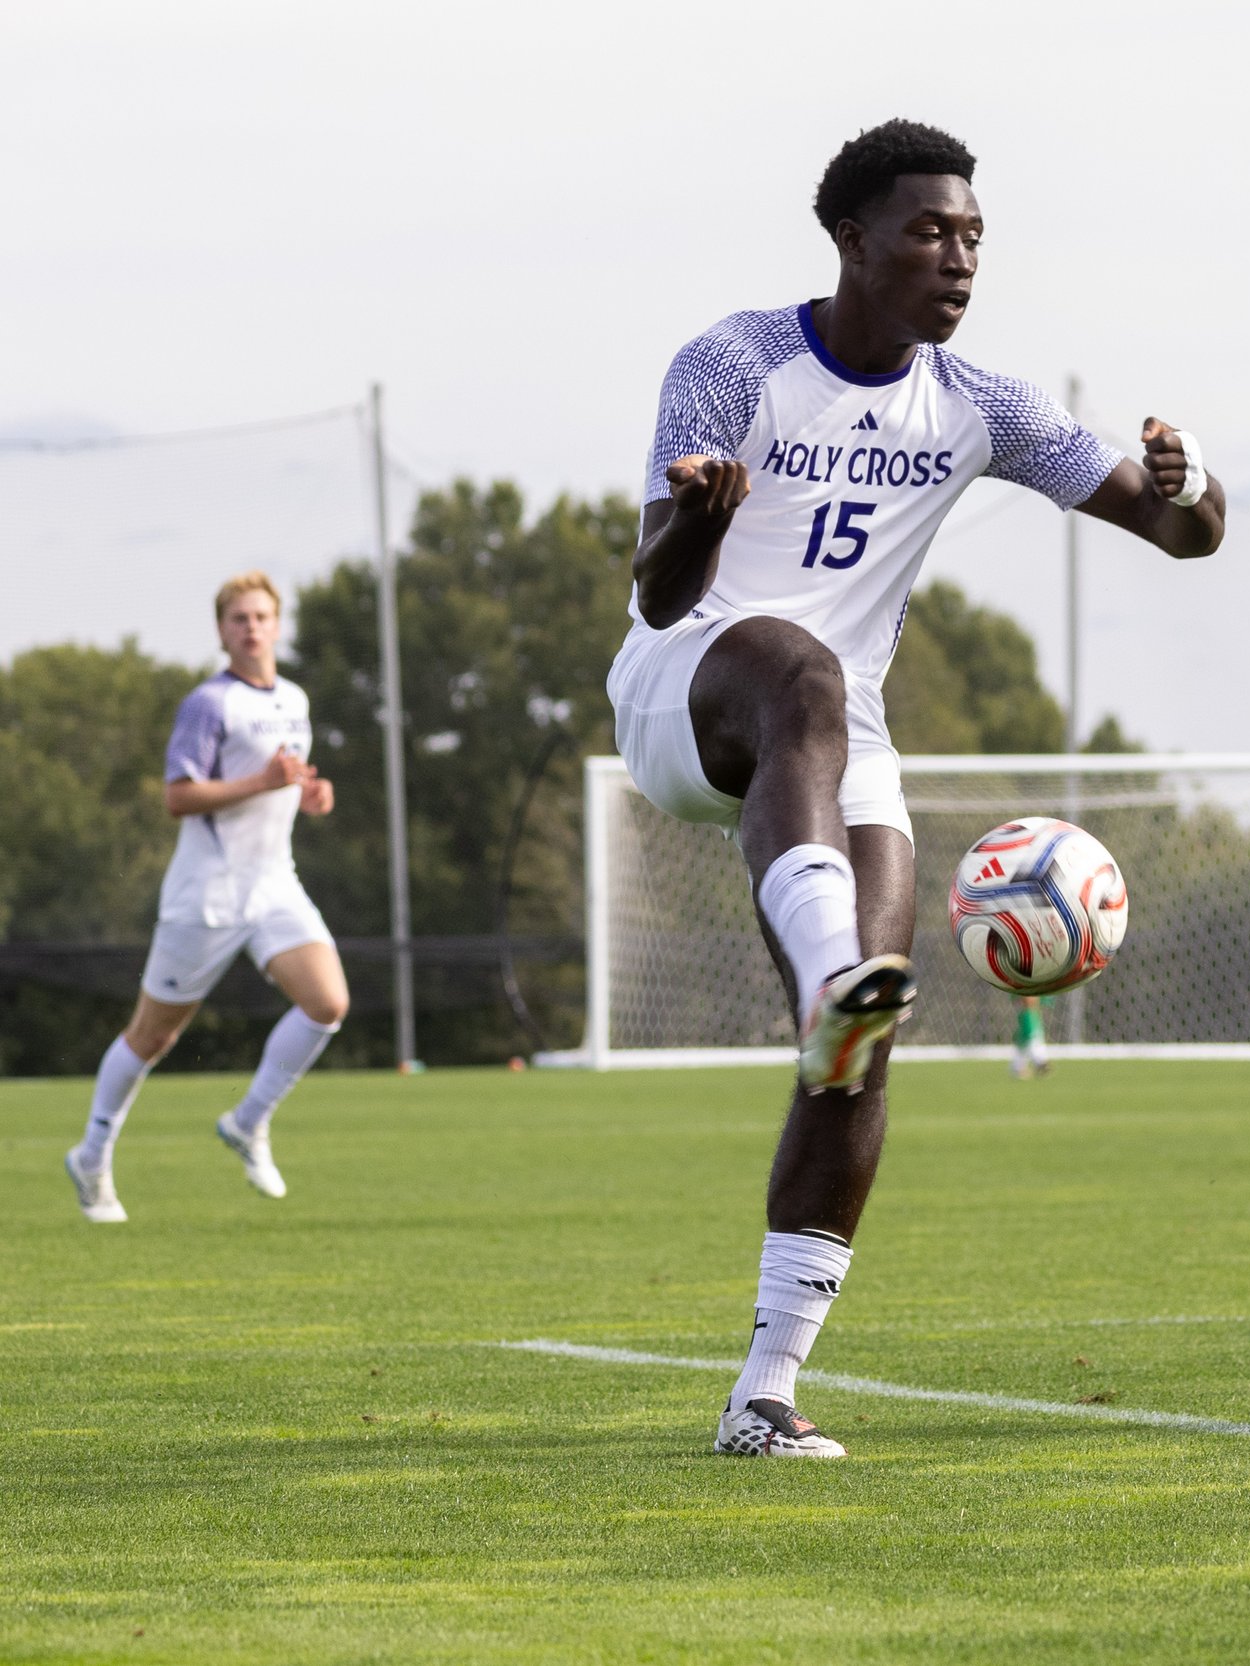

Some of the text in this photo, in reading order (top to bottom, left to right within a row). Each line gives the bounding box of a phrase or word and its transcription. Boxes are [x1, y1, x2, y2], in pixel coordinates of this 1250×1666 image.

[761, 439, 953, 487] HOLY CROSS
[801, 501, 878, 570] 15
